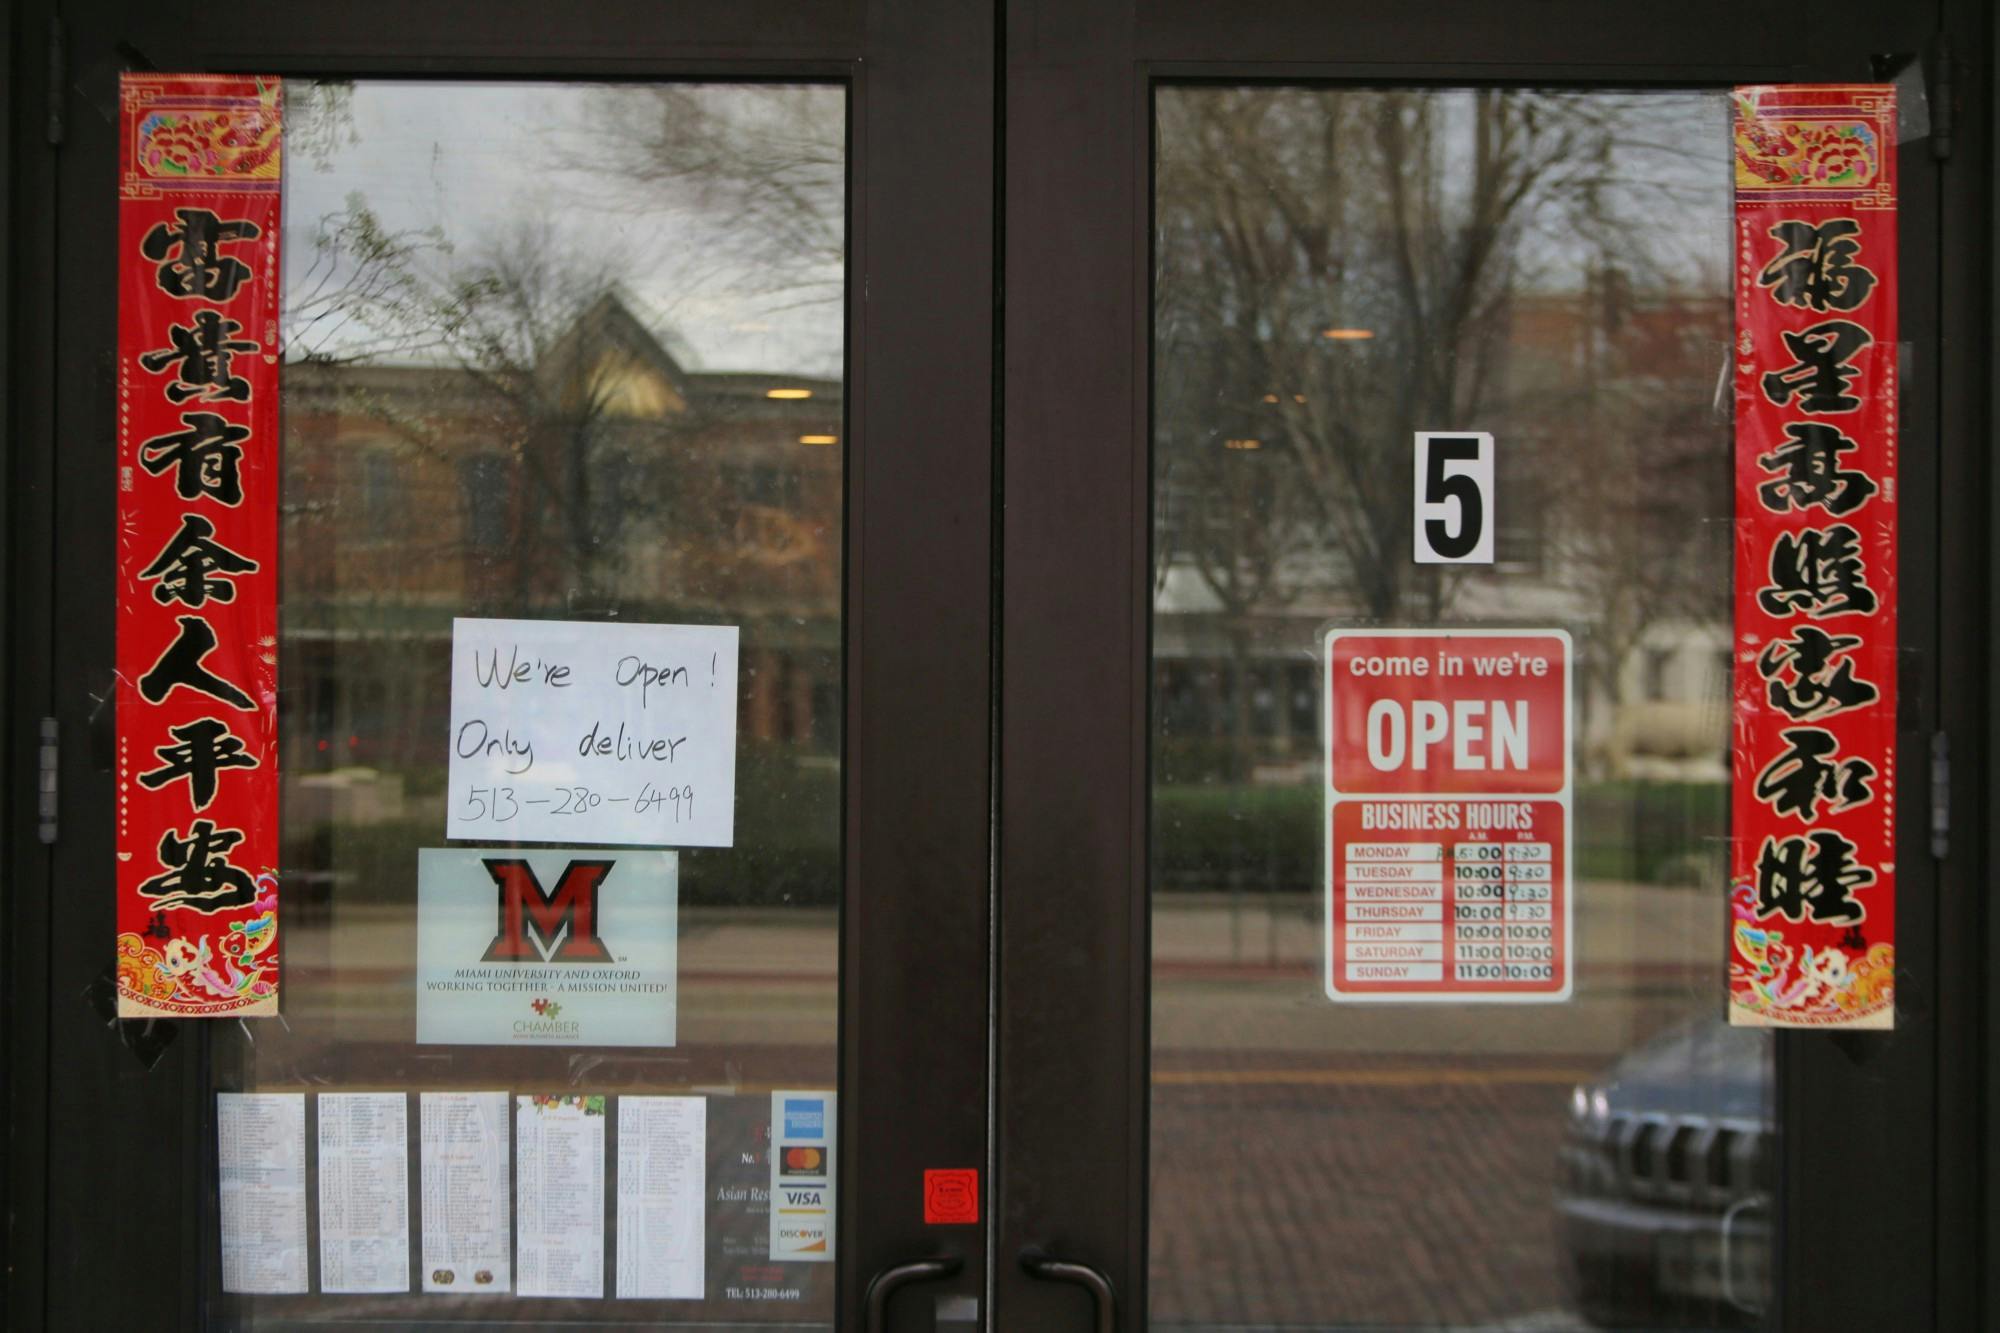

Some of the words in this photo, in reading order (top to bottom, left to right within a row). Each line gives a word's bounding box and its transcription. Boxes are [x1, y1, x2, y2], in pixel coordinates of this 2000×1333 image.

[1424, 437, 1483, 559] 5
[1350, 655, 1429, 676] come
[1438, 651, 1463, 676] in
[1473, 652, 1548, 676] we're
[475, 645, 572, 689] We're
[615, 655, 689, 708] Open
[1367, 698, 1529, 772] OPEN
[456, 720, 534, 774] Only
[578, 721, 687, 763] deliver
[1362, 803, 1460, 830] BUSINESS
[1466, 803, 1533, 830] HOURS
[1354, 847, 1411, 858] MONDAY
[1354, 866, 1413, 878] TUESDAY
[1455, 866, 1503, 880] 10:00
[1354, 886, 1436, 898] WEDNESDAY
[1457, 885, 1504, 899] 10:00
[480, 858, 617, 963] M
[1354, 906, 1424, 918] THURSDAY
[1455, 905, 1503, 919] 10:00
[1355, 926, 1401, 938] FRIDAY
[1457, 926, 1503, 939] 10:00
[1507, 926, 1552, 939] 10:00
[1355, 946, 1424, 958] SATURDAY
[1460, 945, 1502, 959] 11:00
[1507, 945, 1554, 960] 10:00
[454, 968, 491, 979] MIAMI
[495, 968, 561, 980] UNIVERSITY
[563, 969, 589, 980] AND
[593, 969, 641, 980] OXFORD
[1357, 966, 1409, 978] SUNDAY
[1459, 965, 1501, 978] 11:00
[1504, 965, 1553, 978] 10:00
[426, 981, 483, 992] WORKING
[487, 982, 548, 992] TOGETHER
[557, 983, 565, 993] A
[568, 983, 616, 993] MISSION
[620, 983, 668, 994] UNITED!
[513, 1021, 579, 1033] CHAMBER
[717, 1186, 747, 1201] Asian
[786, 1192, 821, 1205] VISA
[780, 1229, 824, 1239] DISCOVER
[726, 1287, 742, 1299] TEL:
